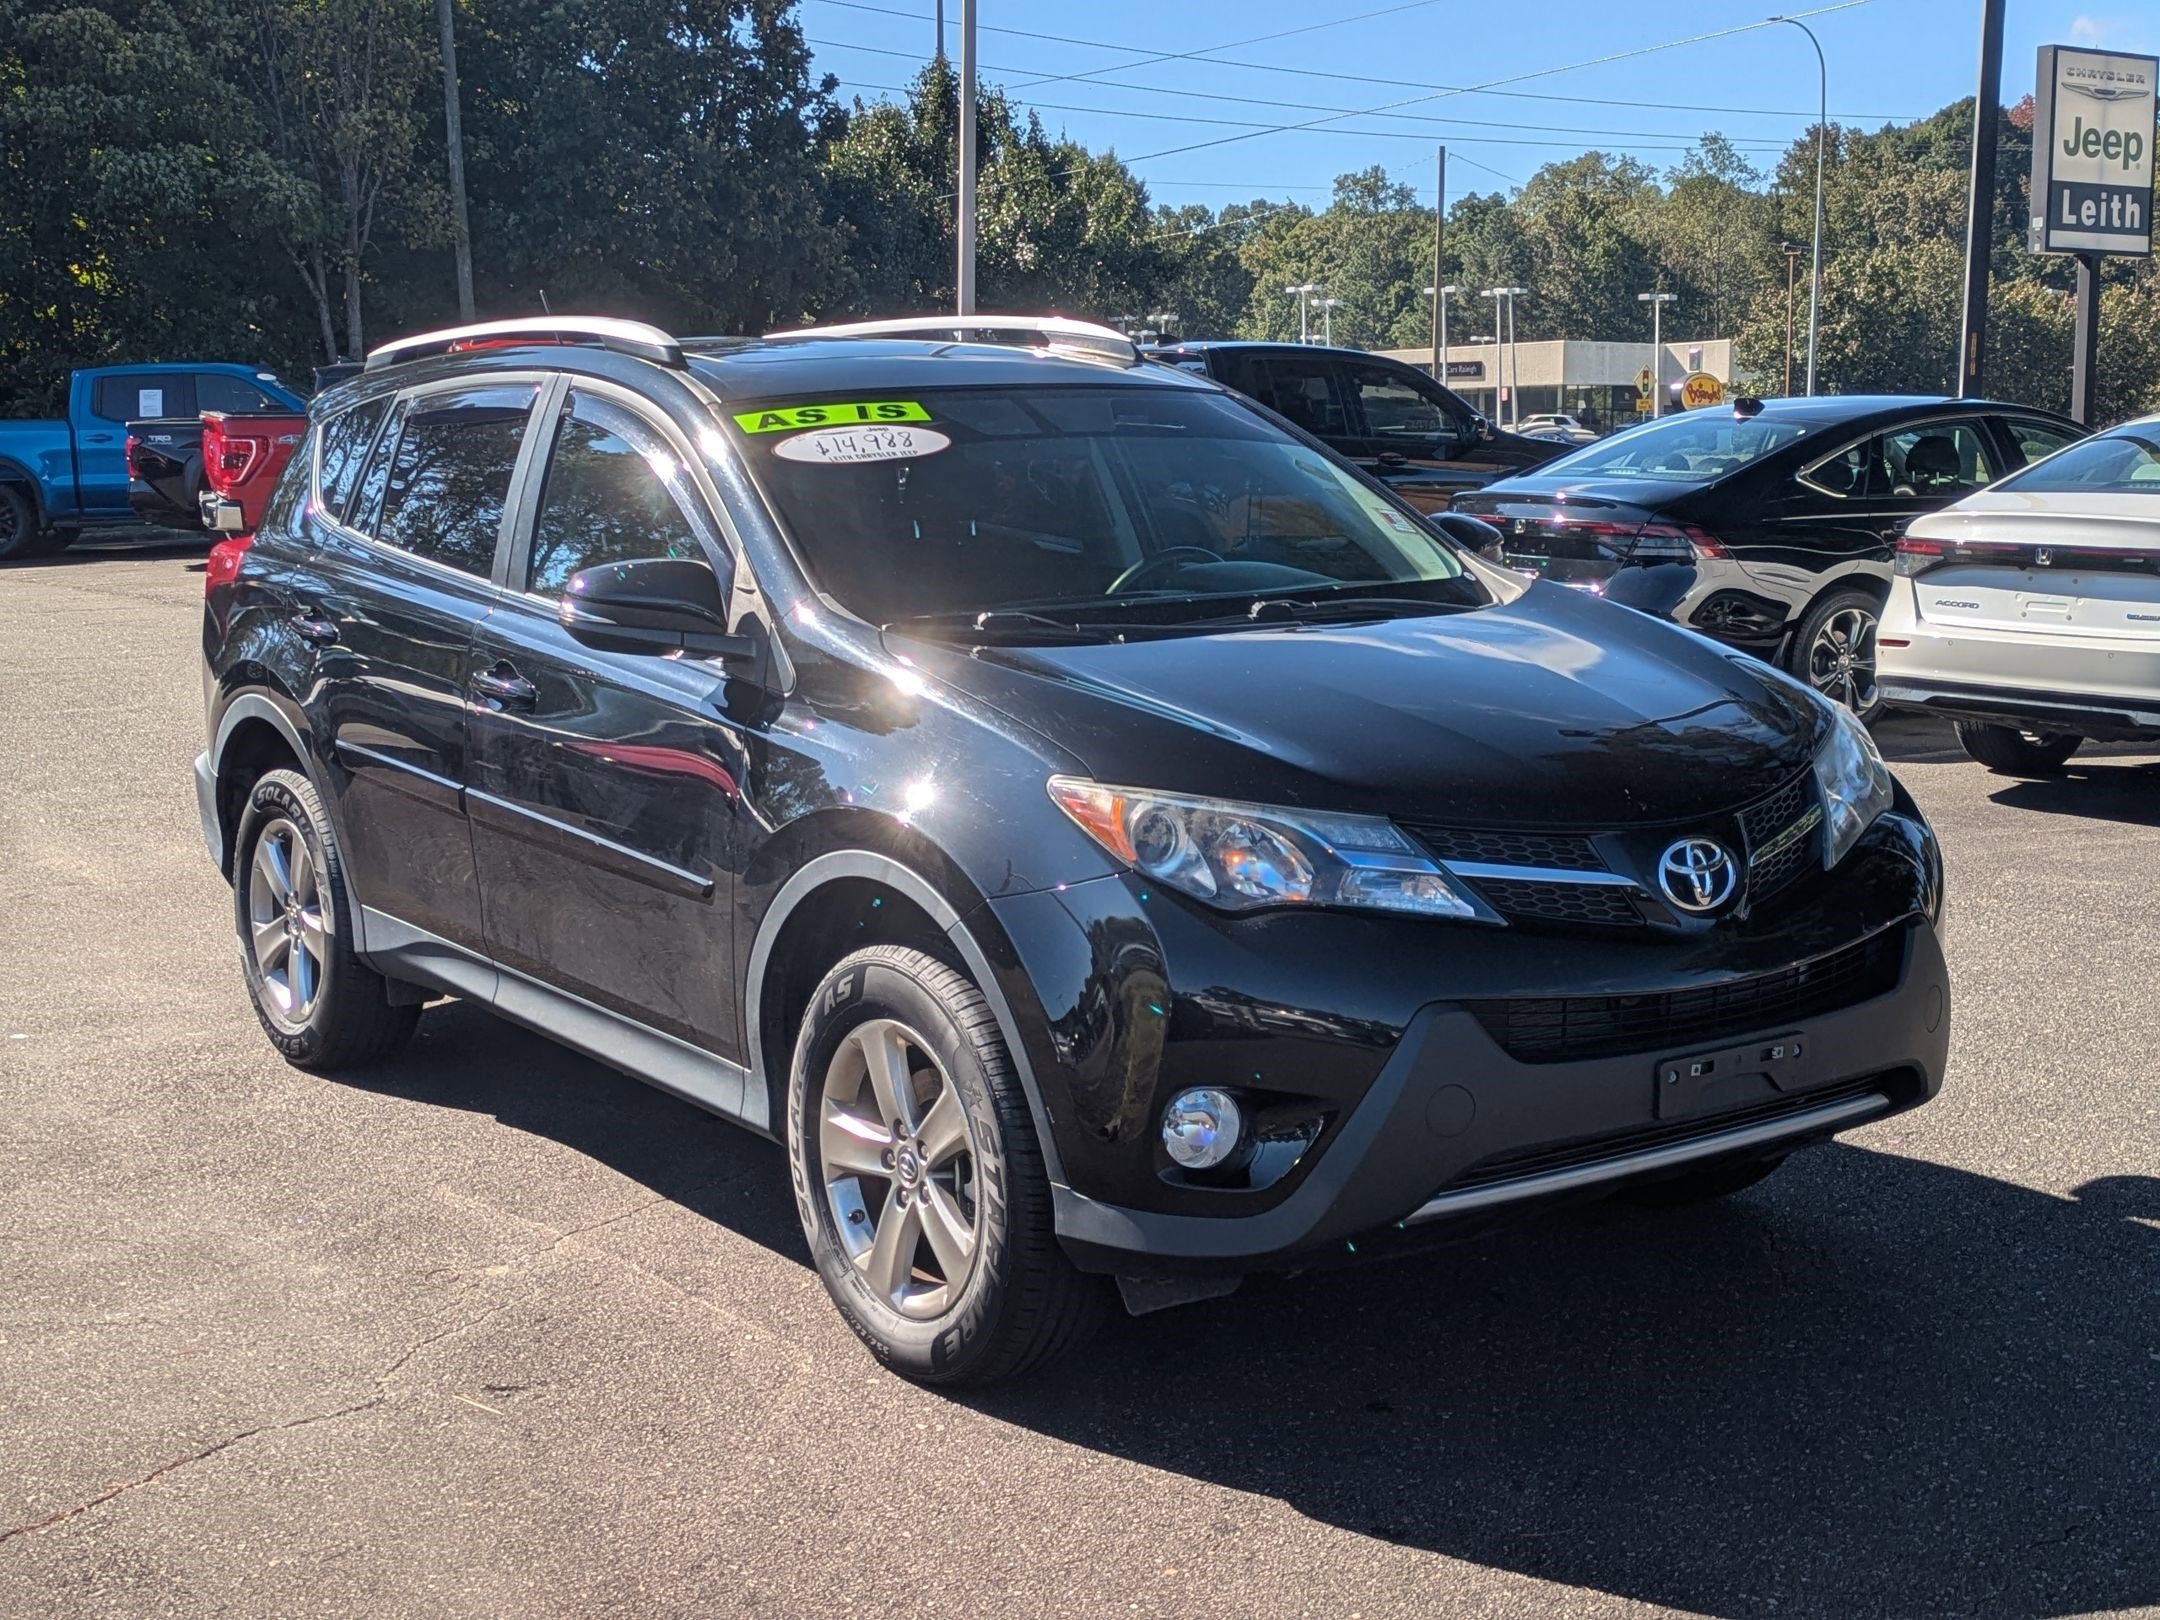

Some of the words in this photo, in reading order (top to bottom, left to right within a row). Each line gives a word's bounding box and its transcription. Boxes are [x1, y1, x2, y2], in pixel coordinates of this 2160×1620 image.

[2066, 66, 2145, 84] CHRYSLER
[2063, 117, 2143, 170] Jeep
[2062, 189, 2141, 229] Leith
[758, 408, 827, 429] AS
[855, 404, 907, 420] IS
[1935, 600, 1980, 609] ACCORD
[824, 973, 855, 1016] AS
